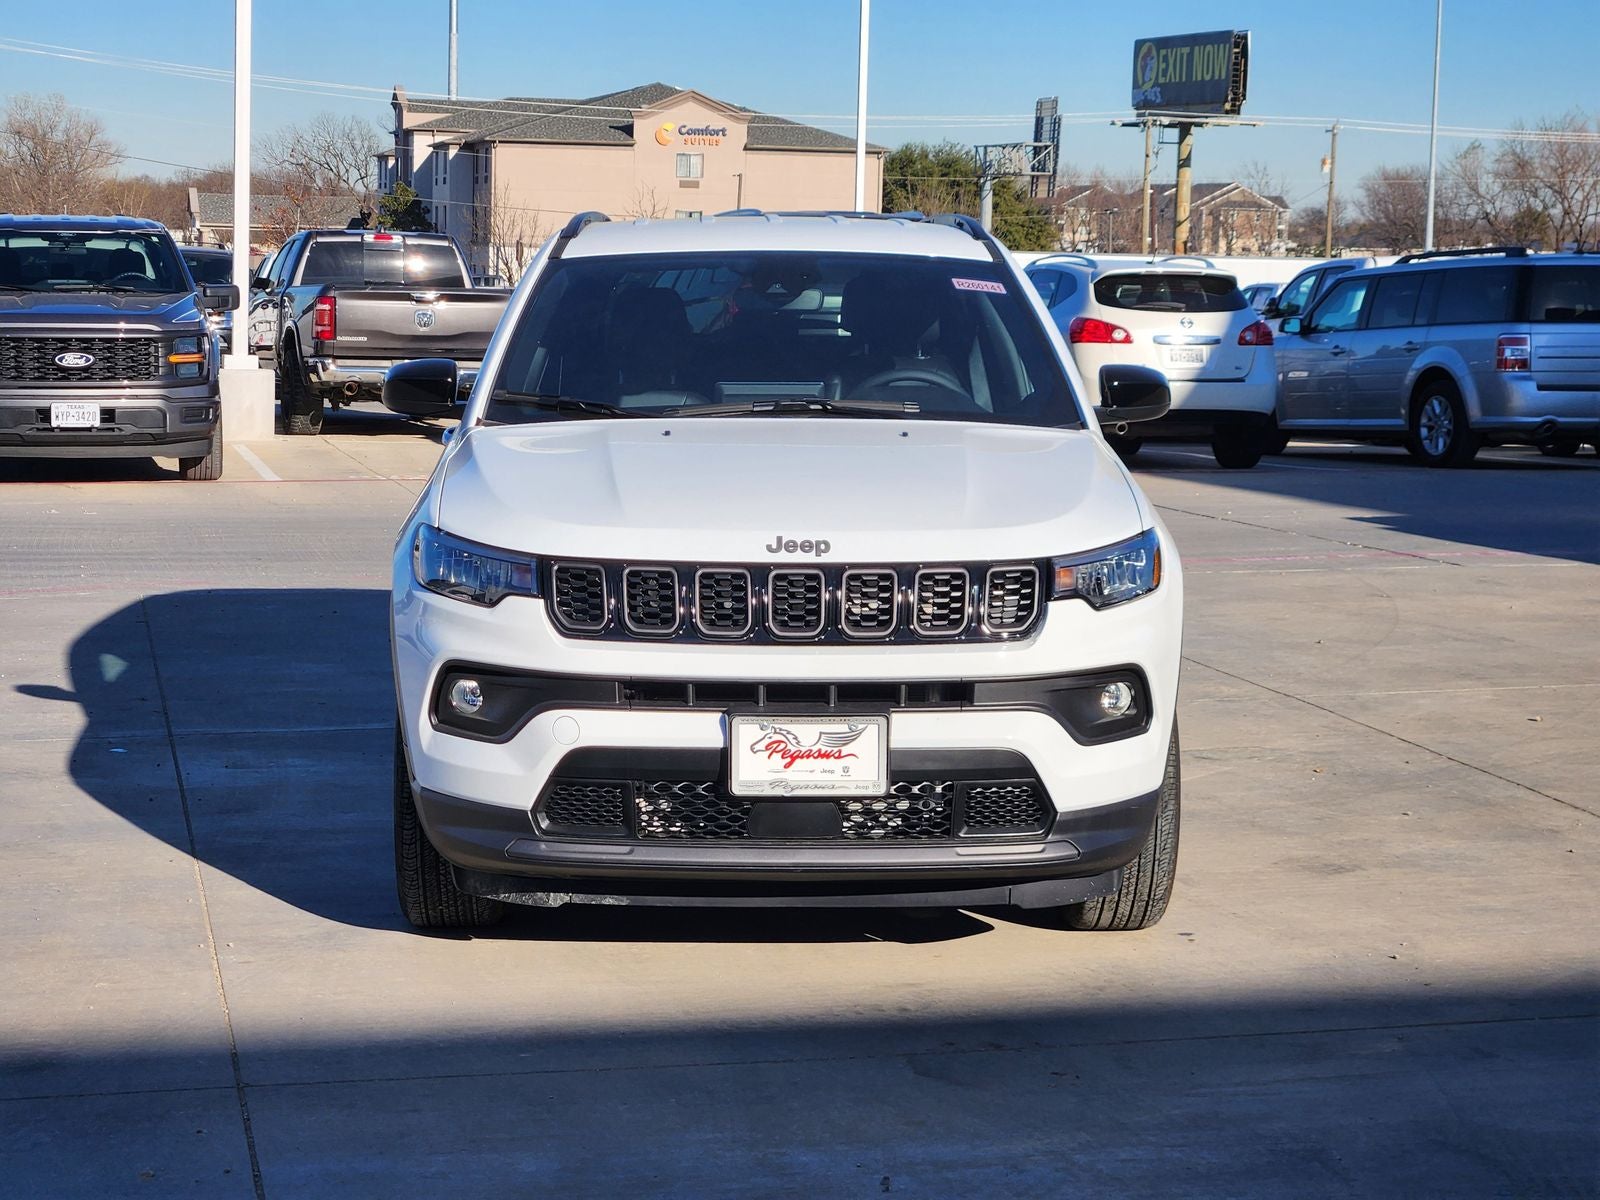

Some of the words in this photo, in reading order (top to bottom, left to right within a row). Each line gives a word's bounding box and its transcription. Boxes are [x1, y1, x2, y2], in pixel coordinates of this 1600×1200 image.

[1158, 47, 1190, 83] EXIT
[1192, 44, 1230, 81] NOW
[678, 125, 727, 137] Comfort
[683, 137, 720, 146] SUITES
[62, 355, 87, 365] Ford
[766, 536, 831, 557] Jeep
[765, 740, 858, 769] Pegasus
[769, 778, 851, 794] Pegasus
